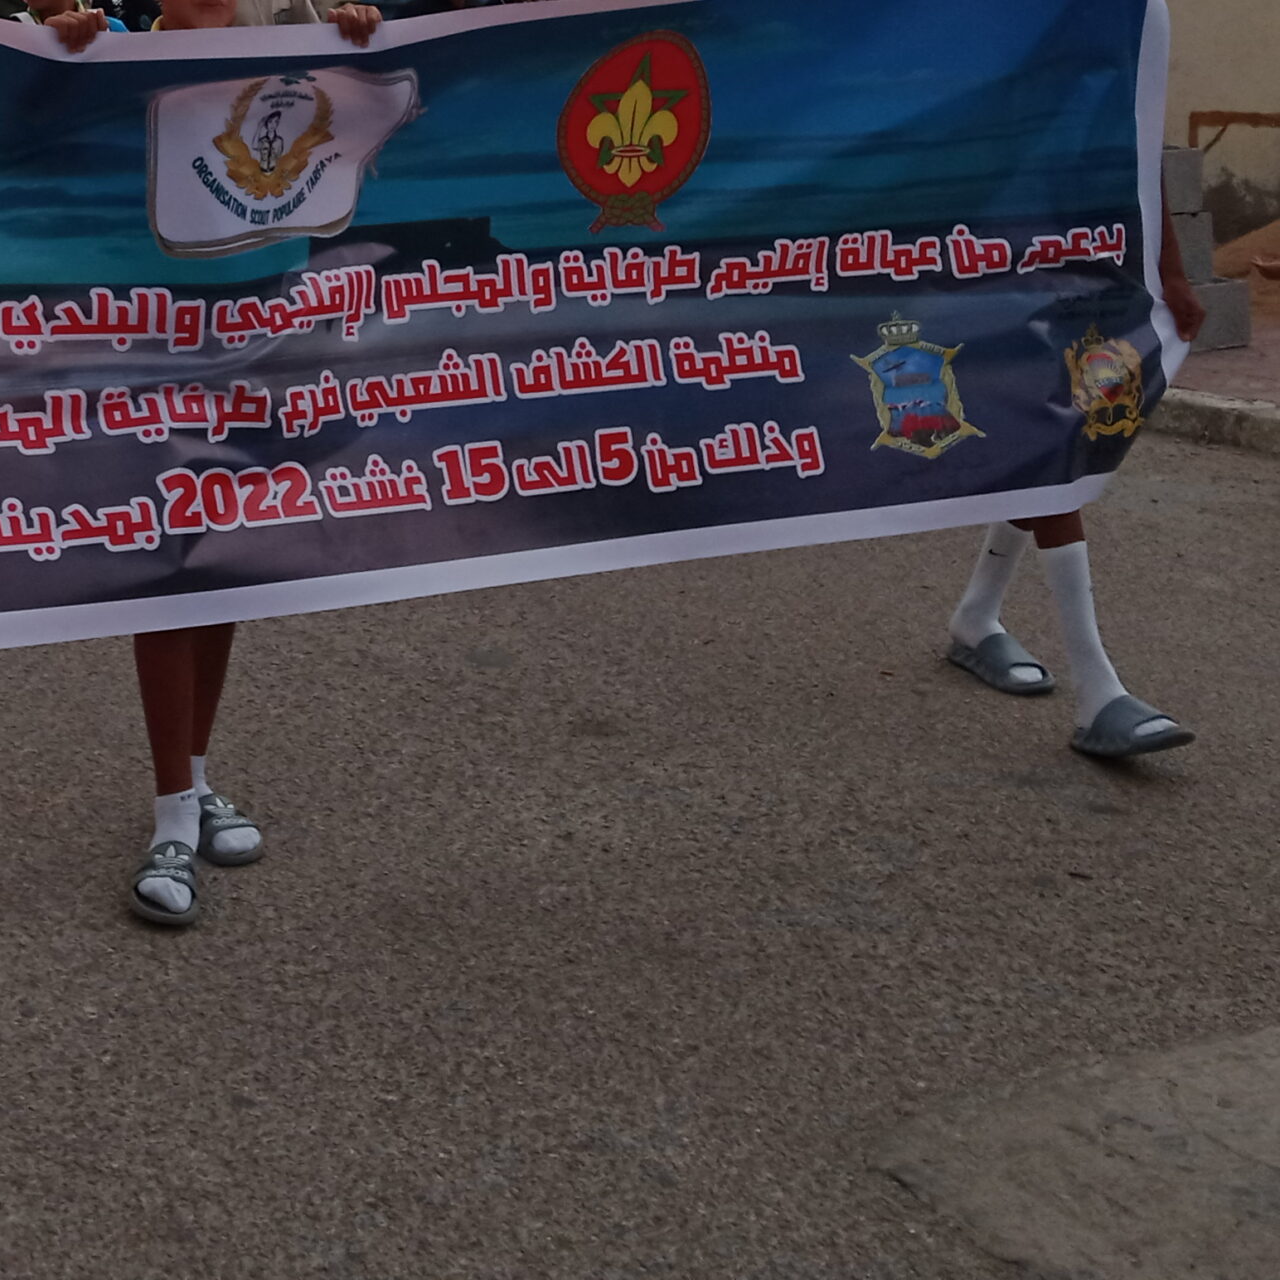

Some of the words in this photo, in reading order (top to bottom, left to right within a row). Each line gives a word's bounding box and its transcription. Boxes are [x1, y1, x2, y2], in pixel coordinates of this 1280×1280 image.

[192, 156, 248, 221] ORGANISATION
[271, 187, 307, 224] POPULAIRE
[305, 152, 342, 194] TARFAYA
[559, 245, 700, 306] طرفاية
[708, 236, 829, 299] إقليم
[836, 229, 942, 280] عمالة
[946, 224, 1011, 279] من
[1018, 223, 1125, 272] بدعم
[212, 264, 375, 341] الإقليمي
[381, 253, 556, 322] والمجلس
[346, 349, 507, 425] الشعبي
[513, 338, 666, 401] الكشاف
[669, 331, 805, 389] منظمة
[97, 378, 271, 443] طرفاية
[279, 371, 345, 437] فرع
[434, 440, 509, 506] 15
[594, 425, 638, 485] 5
[641, 430, 703, 493] من
[700, 421, 824, 477] وذلك
[154, 462, 322, 535] 2022
[318, 454, 432, 518] غشت
